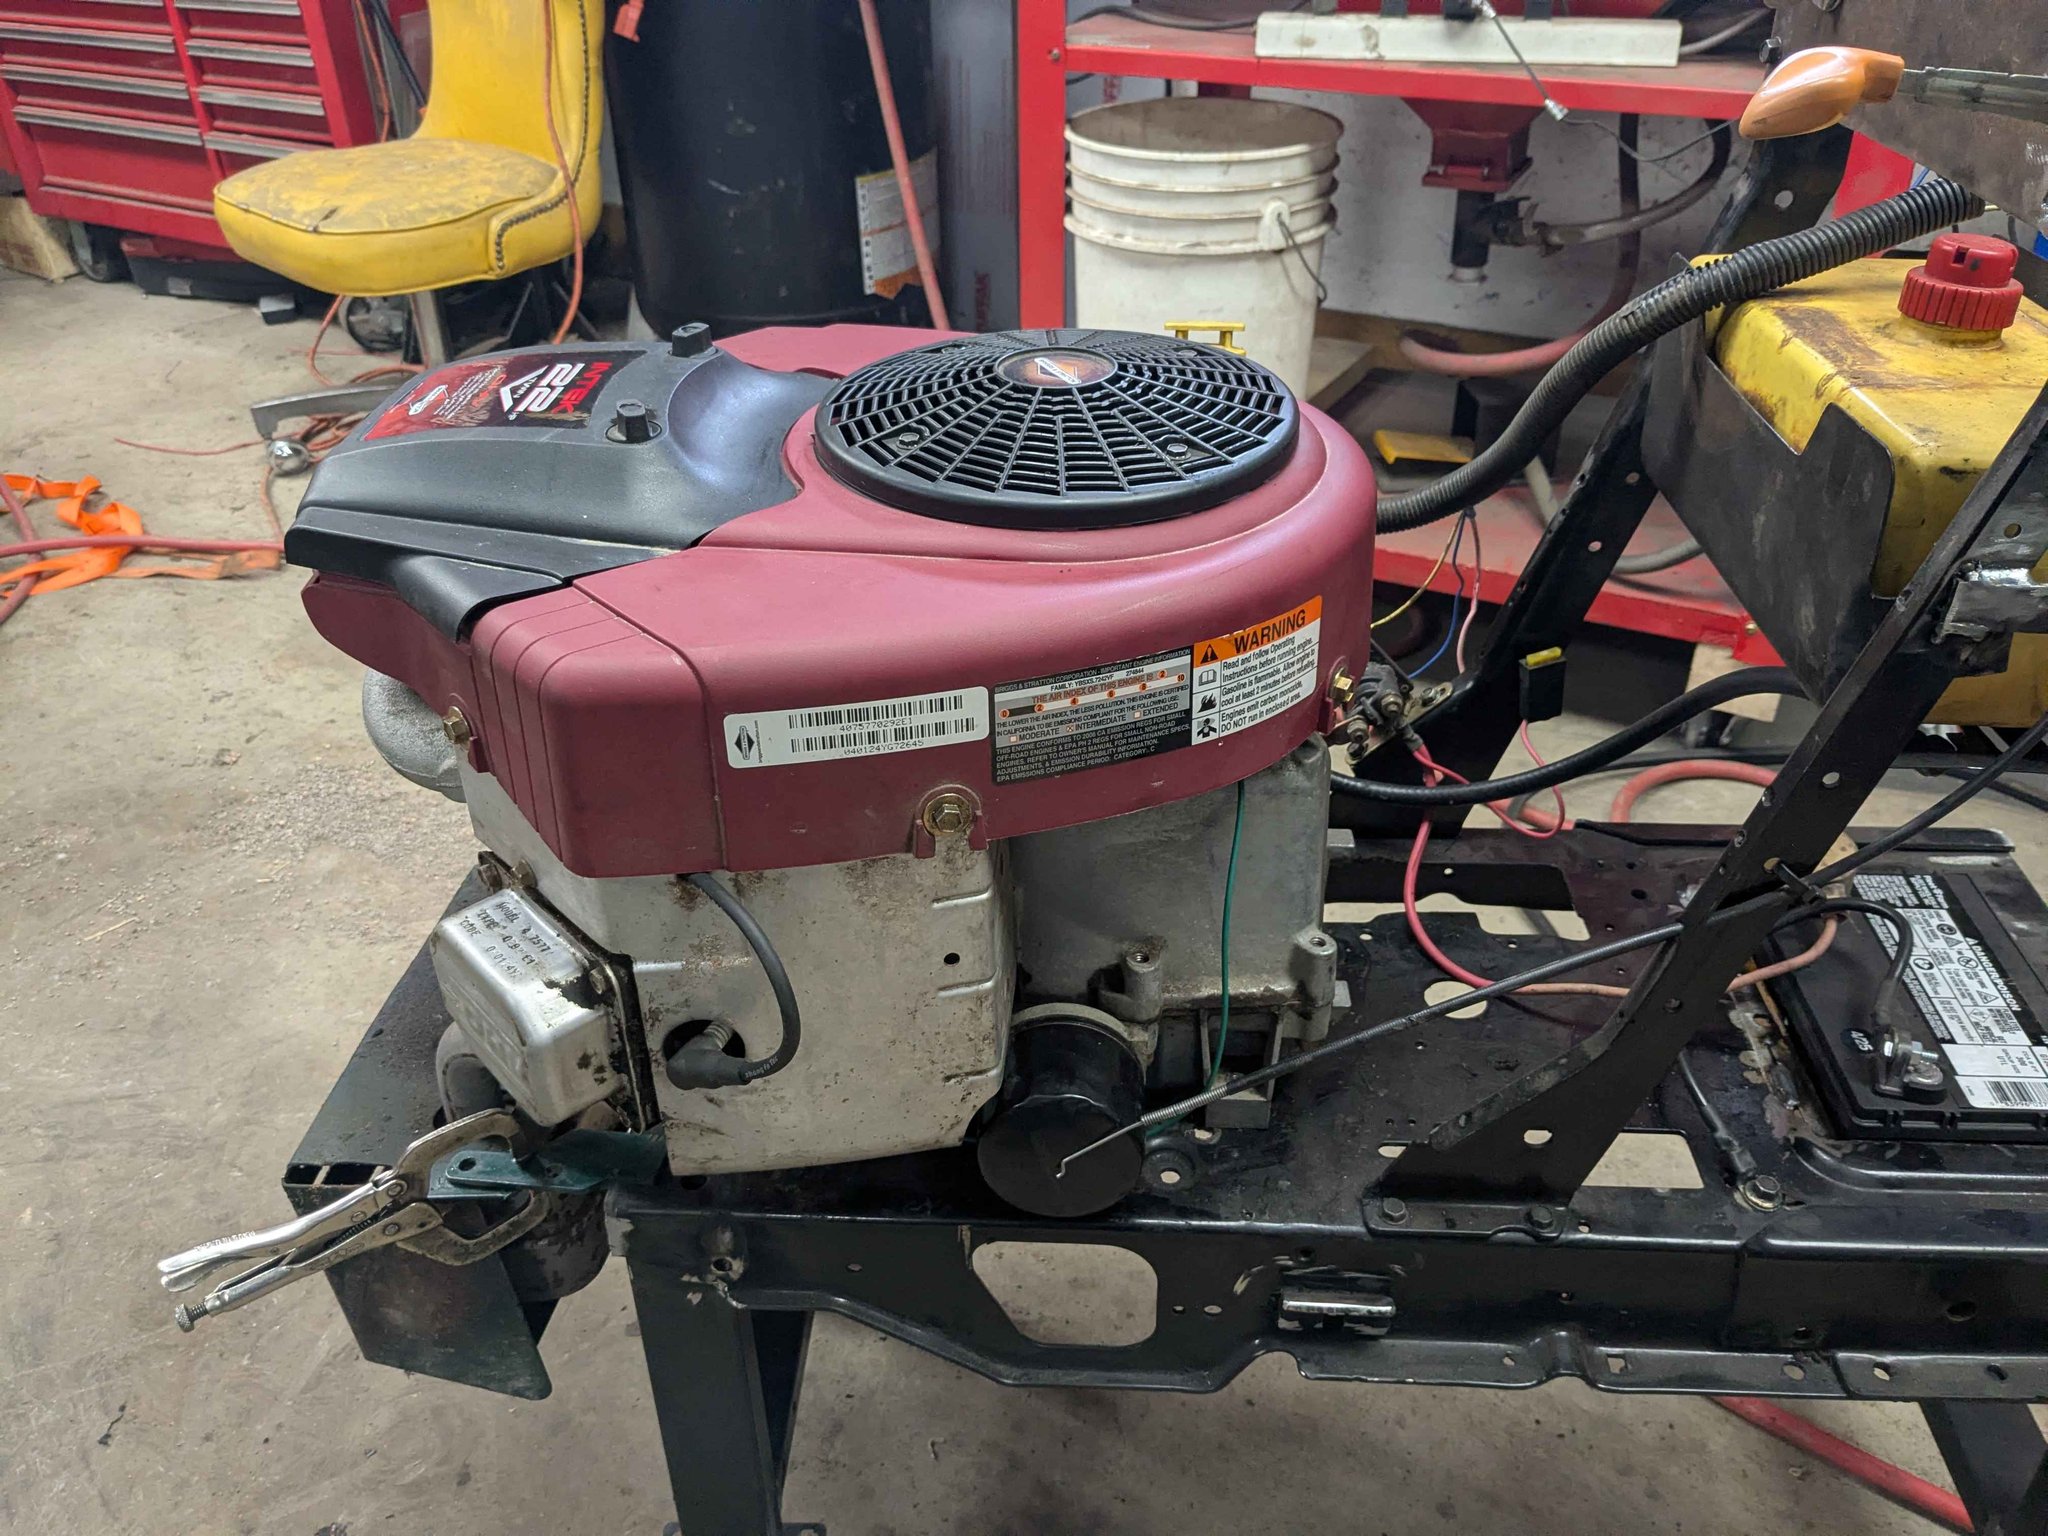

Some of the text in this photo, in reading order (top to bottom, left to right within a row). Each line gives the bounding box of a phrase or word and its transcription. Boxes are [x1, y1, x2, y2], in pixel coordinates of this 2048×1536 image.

[513, 377, 538, 398] TWIN
[515, 363, 586, 412] 22
[551, 362, 613, 414] INTEK
[1234, 609, 1306, 653] WARNING
[995, 683, 1017, 693] BRIGGS
[1024, 676, 1054, 688] STRATTON
[1056, 668, 1096, 682] CORPORATION
[1100, 662, 1131, 673] IMPORTANT
[1133, 656, 1154, 667] ENGINE
[1154, 648, 1190, 662] INFORMATION
[1223, 634, 1294, 672] Read and follow Operating
[1223, 636, 1312, 684] Instructions before running engine.
[1031, 694, 1047, 704] THE
[1048, 691, 1062, 701] AIR
[1063, 686, 1086, 698] INDEX
[1086, 684, 1096, 694] OF
[1098, 680, 1116, 691] THIS
[1117, 674, 1144, 687] ENGINE
[1147, 673, 1153, 681] IS
[1050, 681, 1073, 691] FAMILY:
[1221, 694, 1233, 707] cool
[1235, 693, 1240, 702] at
[1242, 686, 1254, 700] least
[1256, 685, 1259, 694] 2
[1260, 676, 1280, 692] minutes
[1281, 669, 1295, 682] before
[1222, 678, 1246, 697] Gasoline
[1248, 677, 1252, 686] is
[1254, 666, 1281, 684] flammable.
[1283, 659, 1294, 671] Allow
[1296, 651, 1310, 668] engine
[839, 718, 912, 732] 4075770292E1
[996, 721, 1007, 729] THE
[1008, 716, 1029, 727] LOWER
[1029, 714, 1040, 723] THE
[1042, 712, 1050, 720] AIR
[1070, 707, 1080, 715] THE
[1081, 704, 1094, 713] LESS
[1126, 695, 1138, 703] THIS
[1139, 691, 1157, 700] ENGINE
[1163, 684, 1188, 695] CERTIFIED
[1002, 723, 1036, 737] CALIFORNIA
[1036, 722, 1044, 730] TO
[1045, 720, 1052, 728] BE
[1054, 714, 1082, 727] EMISSIONS
[1083, 709, 1112, 721] COMPLIANT
[1114, 706, 1125, 714] FOR
[1126, 704, 1136, 712] THE
[1137, 697, 1166, 709] FOLLOWING
[1019, 702, 1178, 741] MODERATE INTERMEDIATE EXTENDED
[1221, 704, 1245, 724] Engines
[1246, 700, 1258, 712] emit
[1260, 692, 1277, 707] carbon
[1221, 721, 1230, 732] DO
[1233, 715, 1246, 729] NOT
[1248, 713, 1257, 722] run
[1258, 708, 1264, 718] in
[1265, 696, 1289, 715] enclosed
[844, 740, 924, 756] 040124YG72645
[996, 747, 1010, 755] THIS
[1012, 742, 1034, 752] ENGINE
[1036, 735, 1071, 748] CONFORMS
[1106, 723, 1134, 734] EMISSION
[1136, 719, 1152, 727] REGS
[1153, 715, 1165, 723] FOR
[1166, 711, 1184, 720] SMALL
[996, 750, 1028, 762] OFF-ROAD
[1030, 745, 1056, 756] ENGINES
[1064, 741, 1076, 749] EPA
[1092, 735, 1108, 743] REGS
[1124, 728, 1142, 736] SMALL
[1144, 720, 1175, 732] NON-ROAD
[1027, 753, 1047, 763] REFER
[1058, 746, 1086, 757] OWNER'S
[1088, 741, 1112, 751] MANUAL
[1114, 738, 1125, 746] FOR
[1128, 728, 1168, 742] MAINTENANCE
[996, 774, 1009, 782] EPA
[1011, 767, 1044, 780] EMISSIONS
[1046, 760, 1085, 773] COMPLIANCE
[1051, 754, 1079, 765] EMISSION
[1081, 747, 1115, 759] DURABILITY
[1973, 945, 2022, 1010] DANGER/POISON
[1851, 1031, 1873, 1050] 4/25
